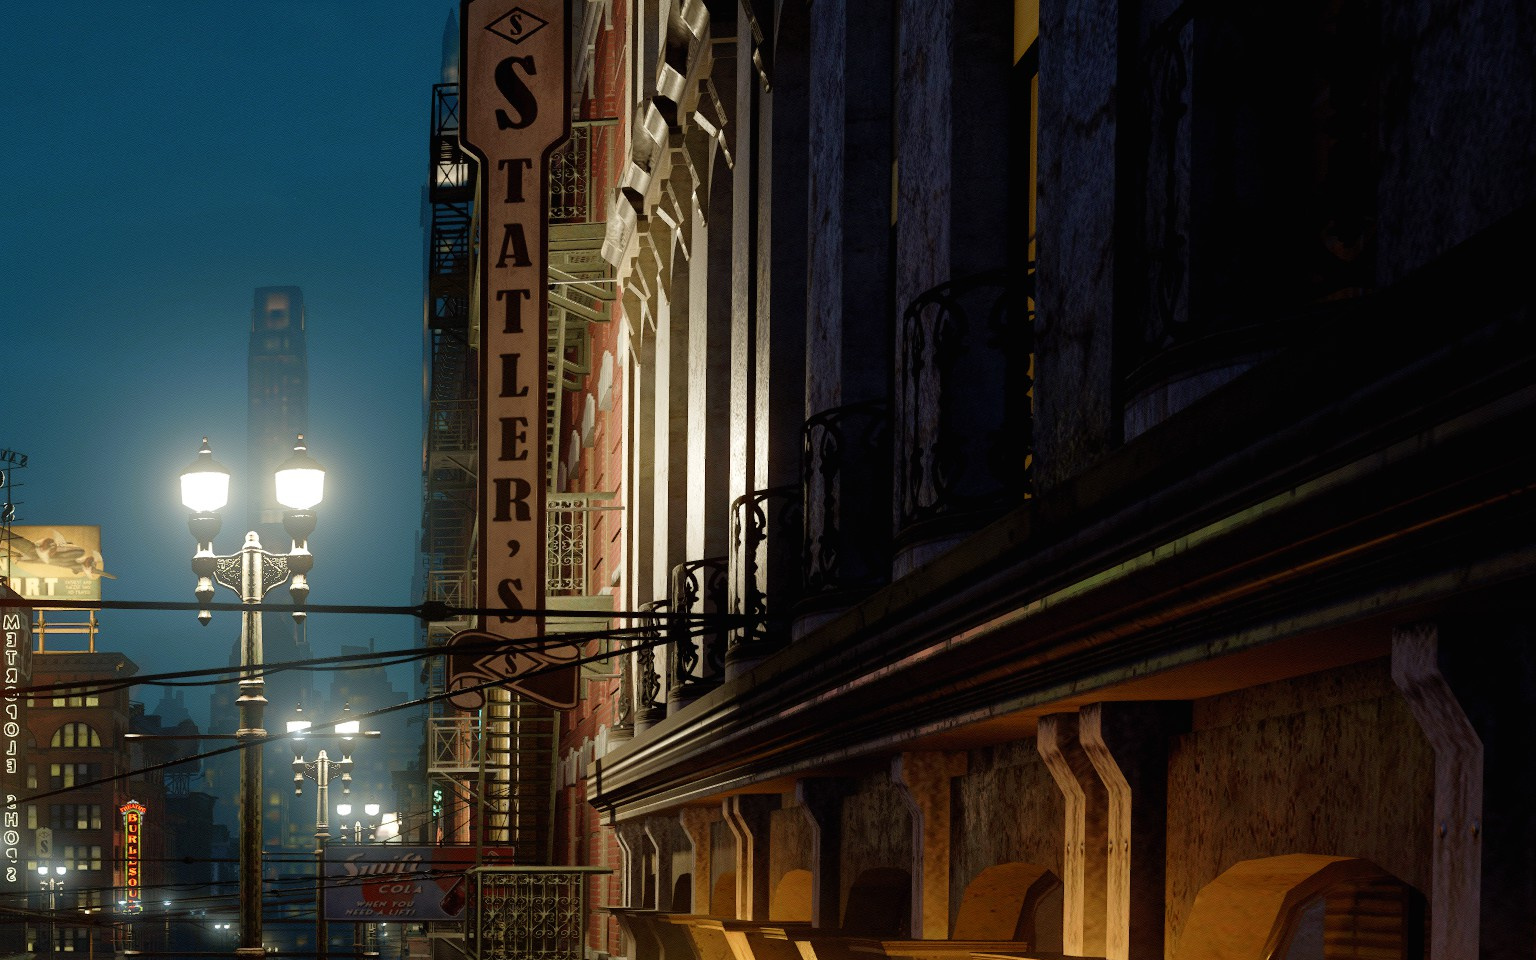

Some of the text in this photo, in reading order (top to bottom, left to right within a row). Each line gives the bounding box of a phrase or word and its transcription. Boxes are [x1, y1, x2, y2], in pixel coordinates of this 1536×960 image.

[508, 12, 524, 36] S
[492, 55, 539, 625] STATLER'S
[336, 852, 424, 885] Swift
[378, 885, 424, 895] COLA
[344, 908, 375, 916] NEED
[356, 900, 415, 908] WHEN YOU
